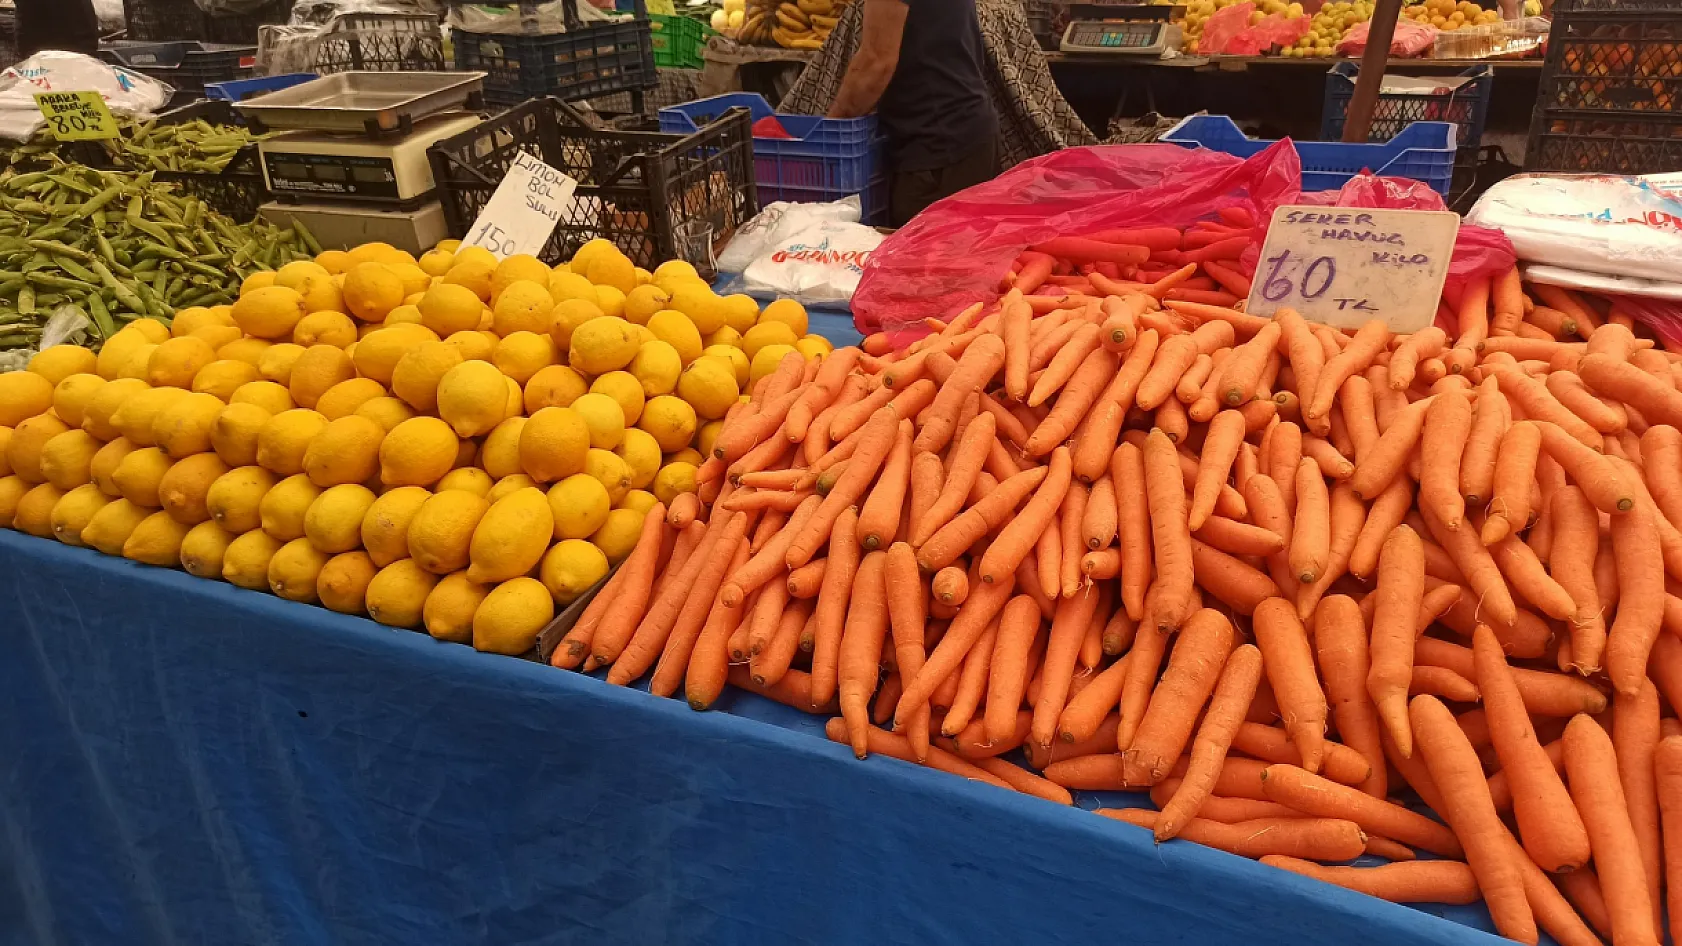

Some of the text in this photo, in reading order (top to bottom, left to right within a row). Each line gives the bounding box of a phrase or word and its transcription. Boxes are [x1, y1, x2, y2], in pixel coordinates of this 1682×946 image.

[48, 115, 86, 134] 80
[528, 176, 555, 200] BOL
[525, 194, 558, 221] SULU
[472, 221, 515, 256] 150
[1261, 249, 1379, 311] 60 TL
